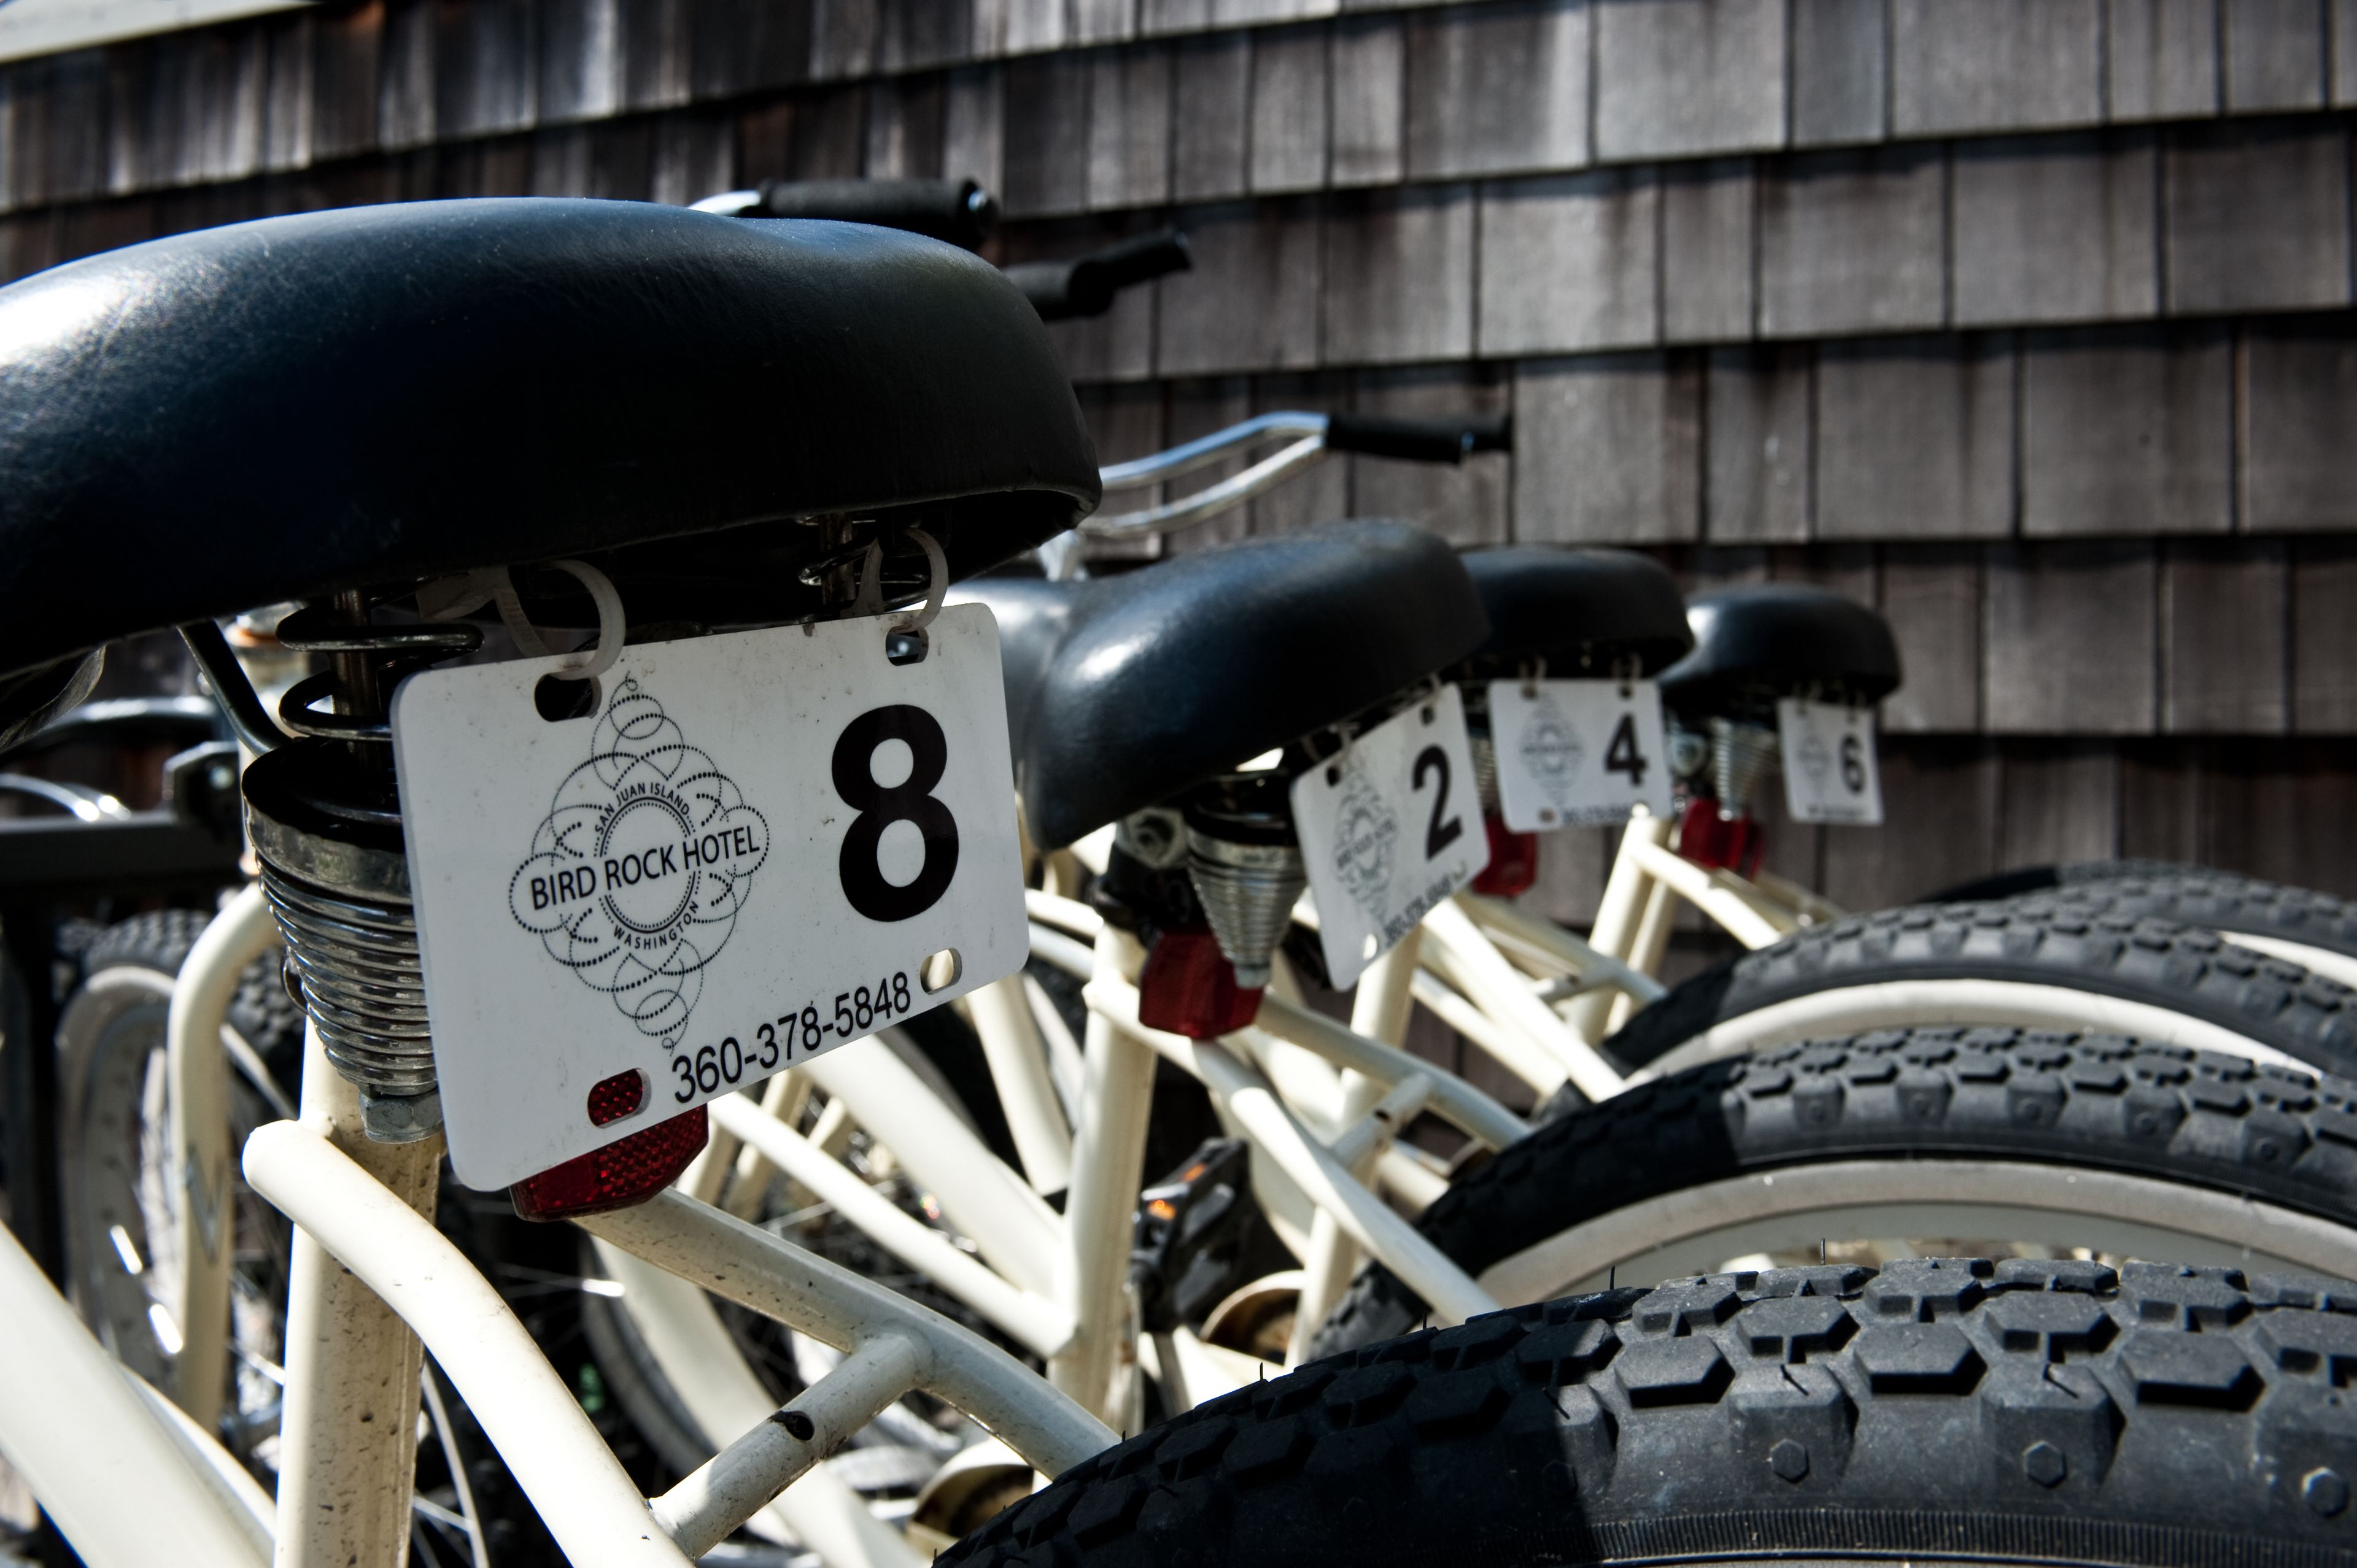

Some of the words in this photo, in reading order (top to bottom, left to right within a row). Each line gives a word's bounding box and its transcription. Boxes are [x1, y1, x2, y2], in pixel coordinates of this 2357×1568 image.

[1604, 712, 1648, 786] 4
[1840, 734, 1867, 795] 6
[595, 805, 615, 835] SAN
[616, 782, 646, 807] JUAN
[650, 781, 690, 816] ISLAND
[831, 703, 959, 922] 8
[1412, 743, 1463, 862] 2
[531, 865, 597, 910] BIRD
[604, 844, 678, 890] ROCK
[683, 825, 761, 870] HOTEL
[613, 900, 699, 950] WASHINGTON
[671, 971, 911, 1103] 360-378-5848
